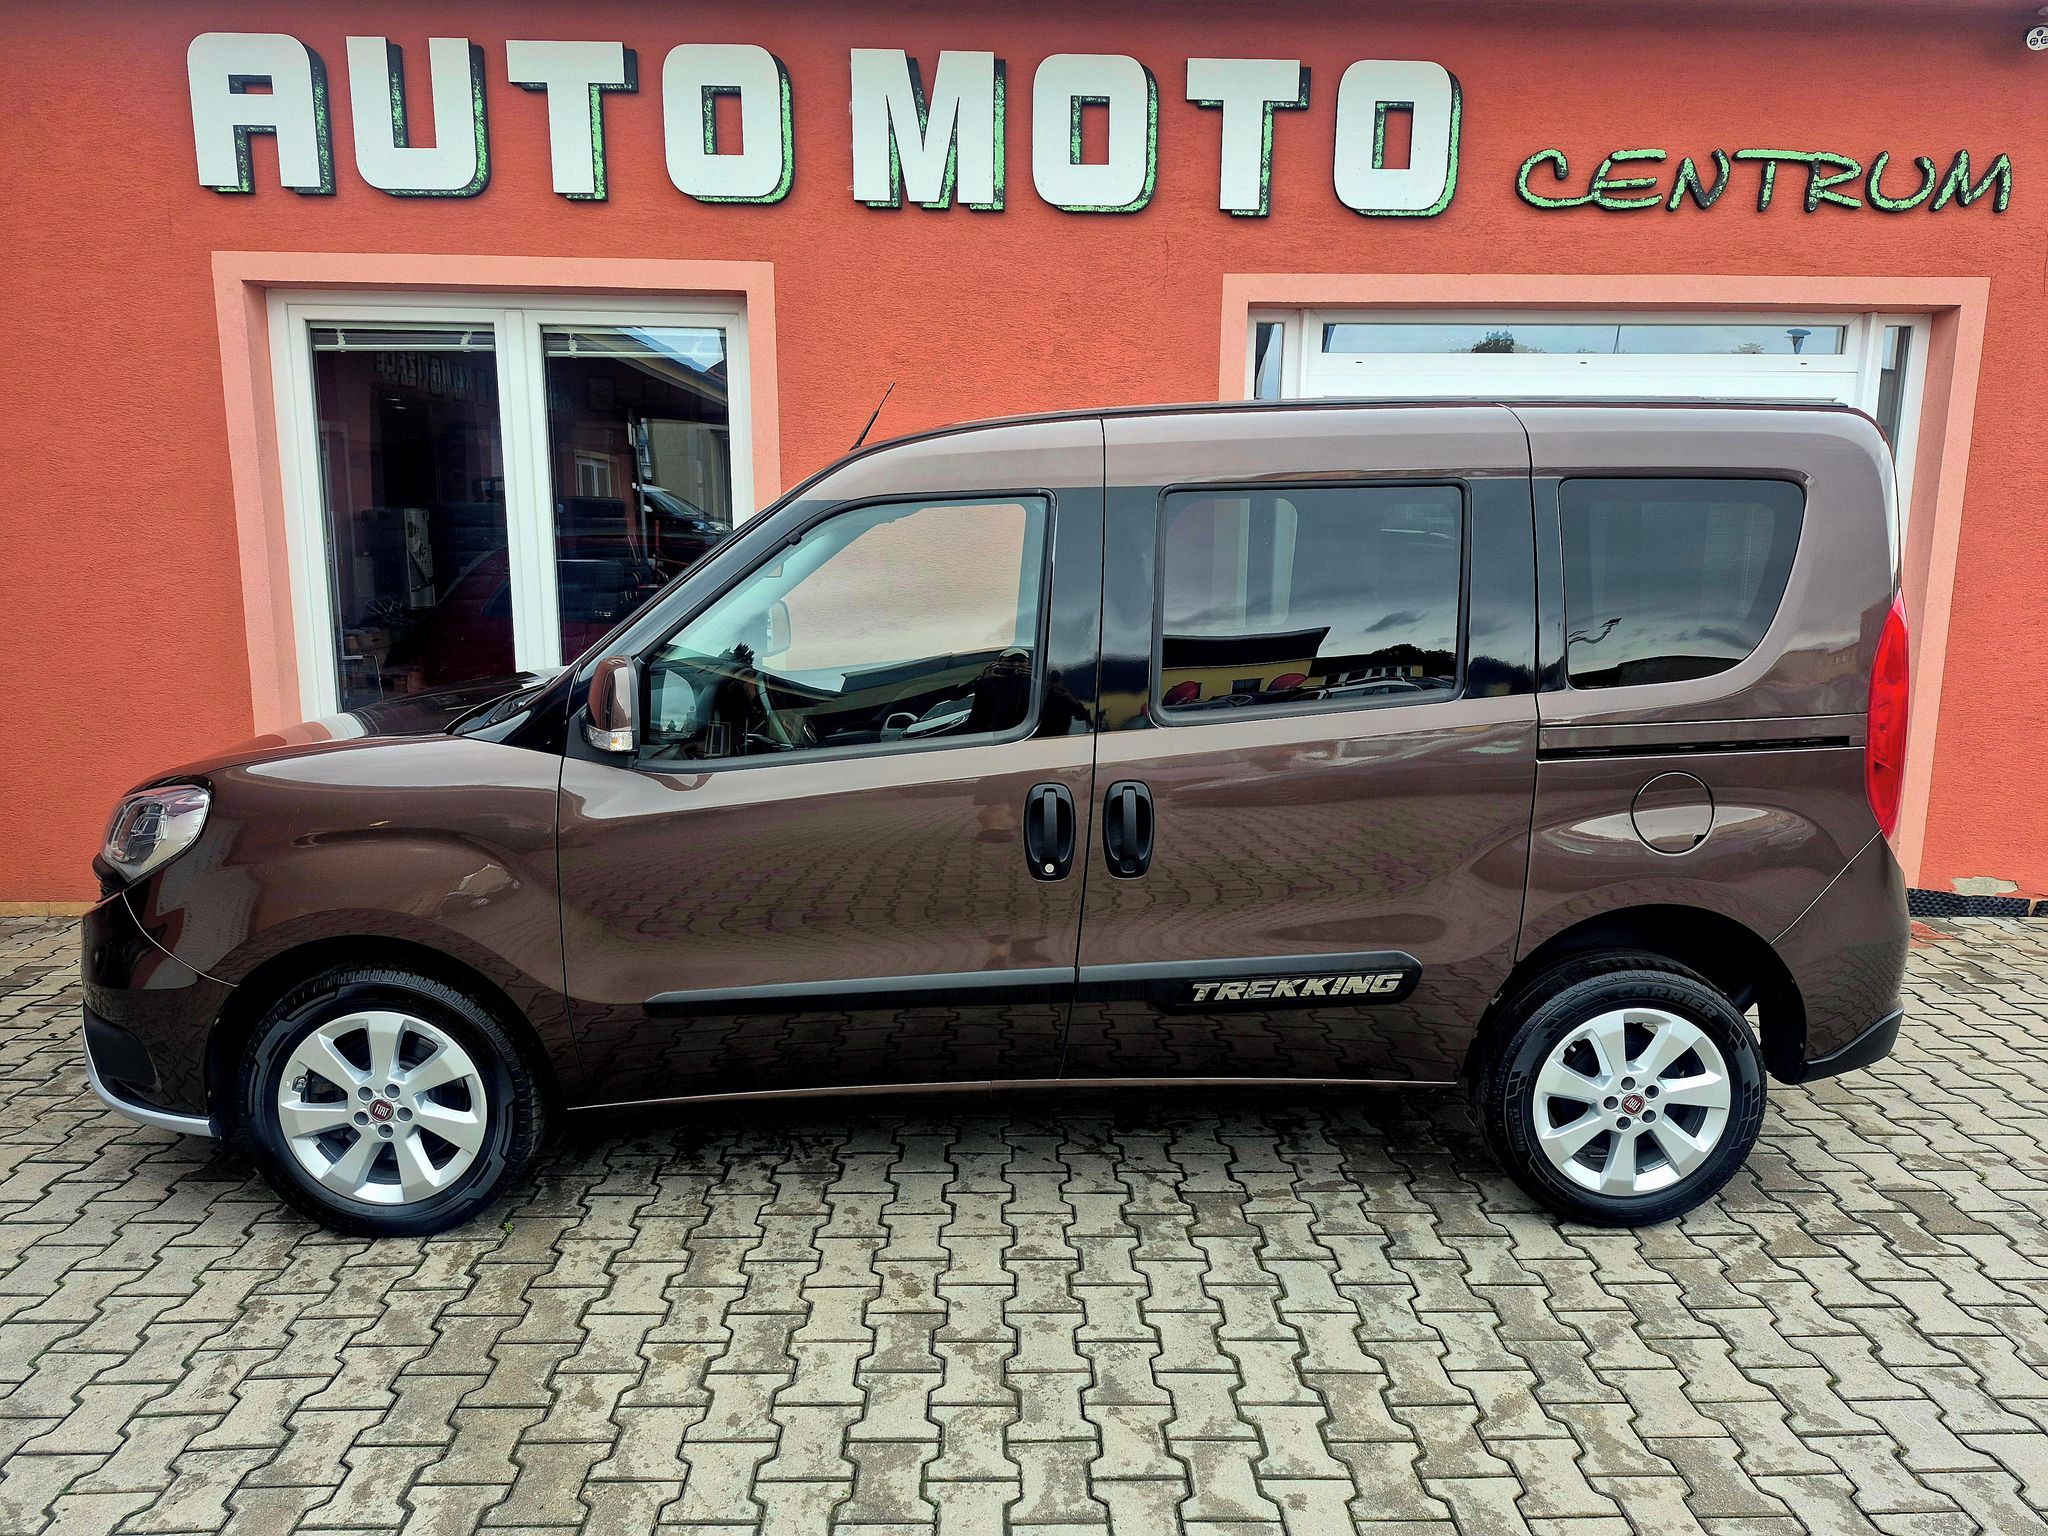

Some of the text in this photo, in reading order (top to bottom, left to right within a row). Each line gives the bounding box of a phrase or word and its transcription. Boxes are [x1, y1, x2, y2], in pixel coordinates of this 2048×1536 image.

[187, 32, 2012, 217] AUTO MOTO CENTRUM
[1192, 973, 1403, 1002] TREKKING
[1617, 985, 1719, 1019] CARRIER
[374, 1103, 391, 1118] FIAT
